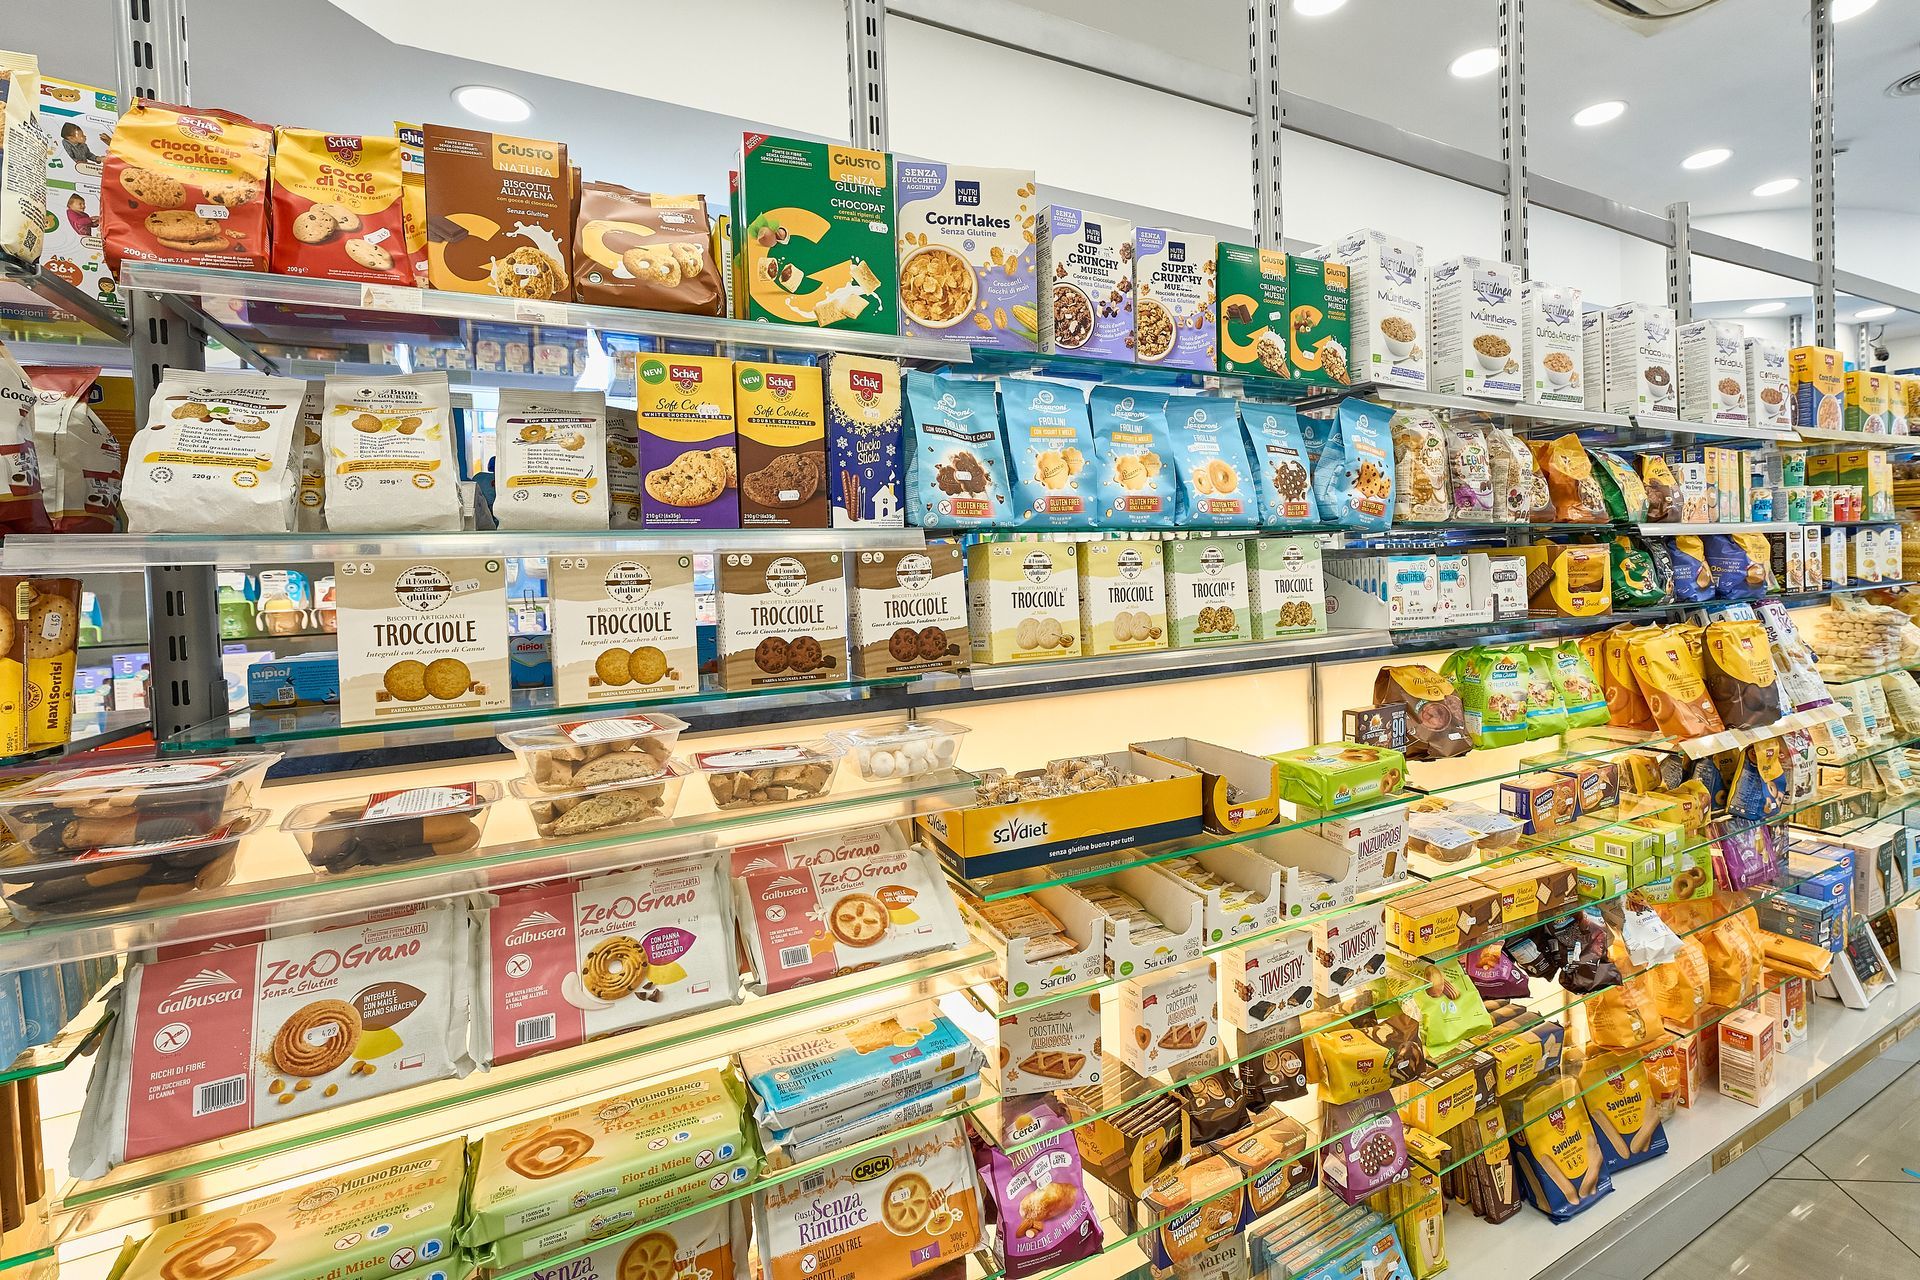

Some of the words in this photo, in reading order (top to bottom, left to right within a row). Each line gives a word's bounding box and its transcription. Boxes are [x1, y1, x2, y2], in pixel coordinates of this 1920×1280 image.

[181, 115, 220, 134] Schär
[151, 138, 200, 151] Choco
[204, 145, 241, 159] Chip
[328, 137, 358, 148] Schär
[163, 151, 228, 165] Cookies
[319, 165, 372, 181] Gocce
[499, 162, 552, 177] NATURA
[905, 168, 938, 177] SENZA
[316, 175, 333, 186] di
[338, 180, 375, 195] Sole
[503, 179, 550, 192] BISCOTTI
[840, 174, 875, 187] SENZA
[902, 176, 941, 184] ZUCCHERI
[835, 182, 882, 197] GLUTINE
[958, 188, 978, 196] NUTRI
[506, 207, 525, 215] Senza
[526, 210, 549, 218] Glutine
[926, 212, 1010, 228] CornFlakes
[940, 228, 964, 236] Senza
[966, 229, 996, 238] Glutine
[1086, 229, 1101, 238] NUTRI
[1087, 235, 1101, 243] FREE
[1170, 247, 1185, 255] NUTRI
[1170, 253, 1185, 261] FREE
[50, 263, 75, 274] 36+
[1069, 253, 1118, 270] CRUNCHY
[1161, 262, 1193, 273] SUPER
[1080, 265, 1109, 277] MUESLI
[1152, 270, 1202, 286] CRUNCHY
[1016, 284, 1029, 292] mais
[1259, 283, 1287, 294] CRUNCHY
[1264, 291, 1285, 301] MUESLI
[1470, 309, 1516, 326] Multiflakes
[643, 368, 662, 377] NEW
[672, 367, 700, 380] Schär
[742, 377, 760, 385] NEW
[768, 376, 793, 390] Schär
[852, 374, 880, 388] Schär
[754, 405, 774, 417] Soft
[776, 406, 809, 418] Cookies
[1039, 417, 1066, 426] FROLLINI
[857, 452, 880, 465] Sticks
[1275, 578, 1313, 593] TROCCIOLE
[407, 593, 442, 602] glutine
[1011, 591, 1065, 609] TROCCIOLE
[1108, 585, 1154, 603] TROCCIOLE
[884, 596, 948, 618] TROCCIOLE
[751, 604, 824, 626] TROCCIOLE
[587, 612, 672, 636] TROCCIOLE
[760, 627, 786, 635] Cioccolato
[373, 621, 476, 647] TROCCIOLE
[366, 650, 399, 658] Integrali
[47, 661, 63, 694] Sorrisi
[252, 668, 290, 679] nipiol
[47, 696, 58, 729] Maxi
[1049, 849, 1067, 858] senza
[1068, 844, 1090, 856] glutine
[1090, 841, 1109, 850] buono
[1111, 840, 1120, 849] per
[1121, 835, 1134, 844] tutti
[682, 876, 699, 887] CARTA
[761, 886, 808, 901] Galbusera
[580, 926, 604, 937] Senza
[606, 919, 636, 931] Glutine
[505, 927, 566, 947] Galbusera
[651, 936, 662, 944] CON
[662, 932, 680, 942] PANNA
[656, 941, 673, 950] GOCCE
[673, 939, 679, 947] DI
[1339, 925, 1377, 964] TWISTY
[652, 945, 683, 959] CIOCCOLATO
[1260, 956, 1303, 997] TWISTY
[262, 984, 296, 1001] Senza
[298, 976, 339, 992] Glutine
[363, 989, 397, 1002] INTEGRALE
[157, 988, 243, 1015] Galbusera
[363, 1001, 376, 1010] CON
[378, 998, 393, 1008] MAIS
[363, 1007, 383, 1018] GRANO
[385, 999, 418, 1015] SARACENO
[1166, 995, 1198, 1013] CROSTATINA
[1029, 1023, 1073, 1037] CROSTATINA
[150, 1069, 176, 1081] RICCHI
[177, 1067, 183, 1075] DI
[185, 1061, 206, 1073] FIBRE
[667, 1081, 701, 1094] BIANCO
[776, 1075, 809, 1091] BISCOTTI
[1606, 1092, 1642, 1112] Savoiardi
[1012, 1118, 1041, 1140] Céréal
[1552, 1130, 1582, 1156] Savoiardi
[389, 1159, 432, 1177] BIANCO
[622, 1170, 646, 1185] Fior
[648, 1166, 659, 1177] di
[661, 1155, 692, 1172] Miele
[856, 1158, 890, 1178] CRICH
[638, 1191, 663, 1208] Fior
[665, 1187, 676, 1198] di
[678, 1178, 706, 1195] Miele
[813, 1192, 863, 1221] Senza
[798, 1207, 869, 1246] Rinunce
[1173, 1215, 1202, 1242] Hobnobs
[1177, 1230, 1198, 1248] AVENA
[817, 1241, 844, 1262] GLUTEN
[846, 1236, 862, 1251] FREE
